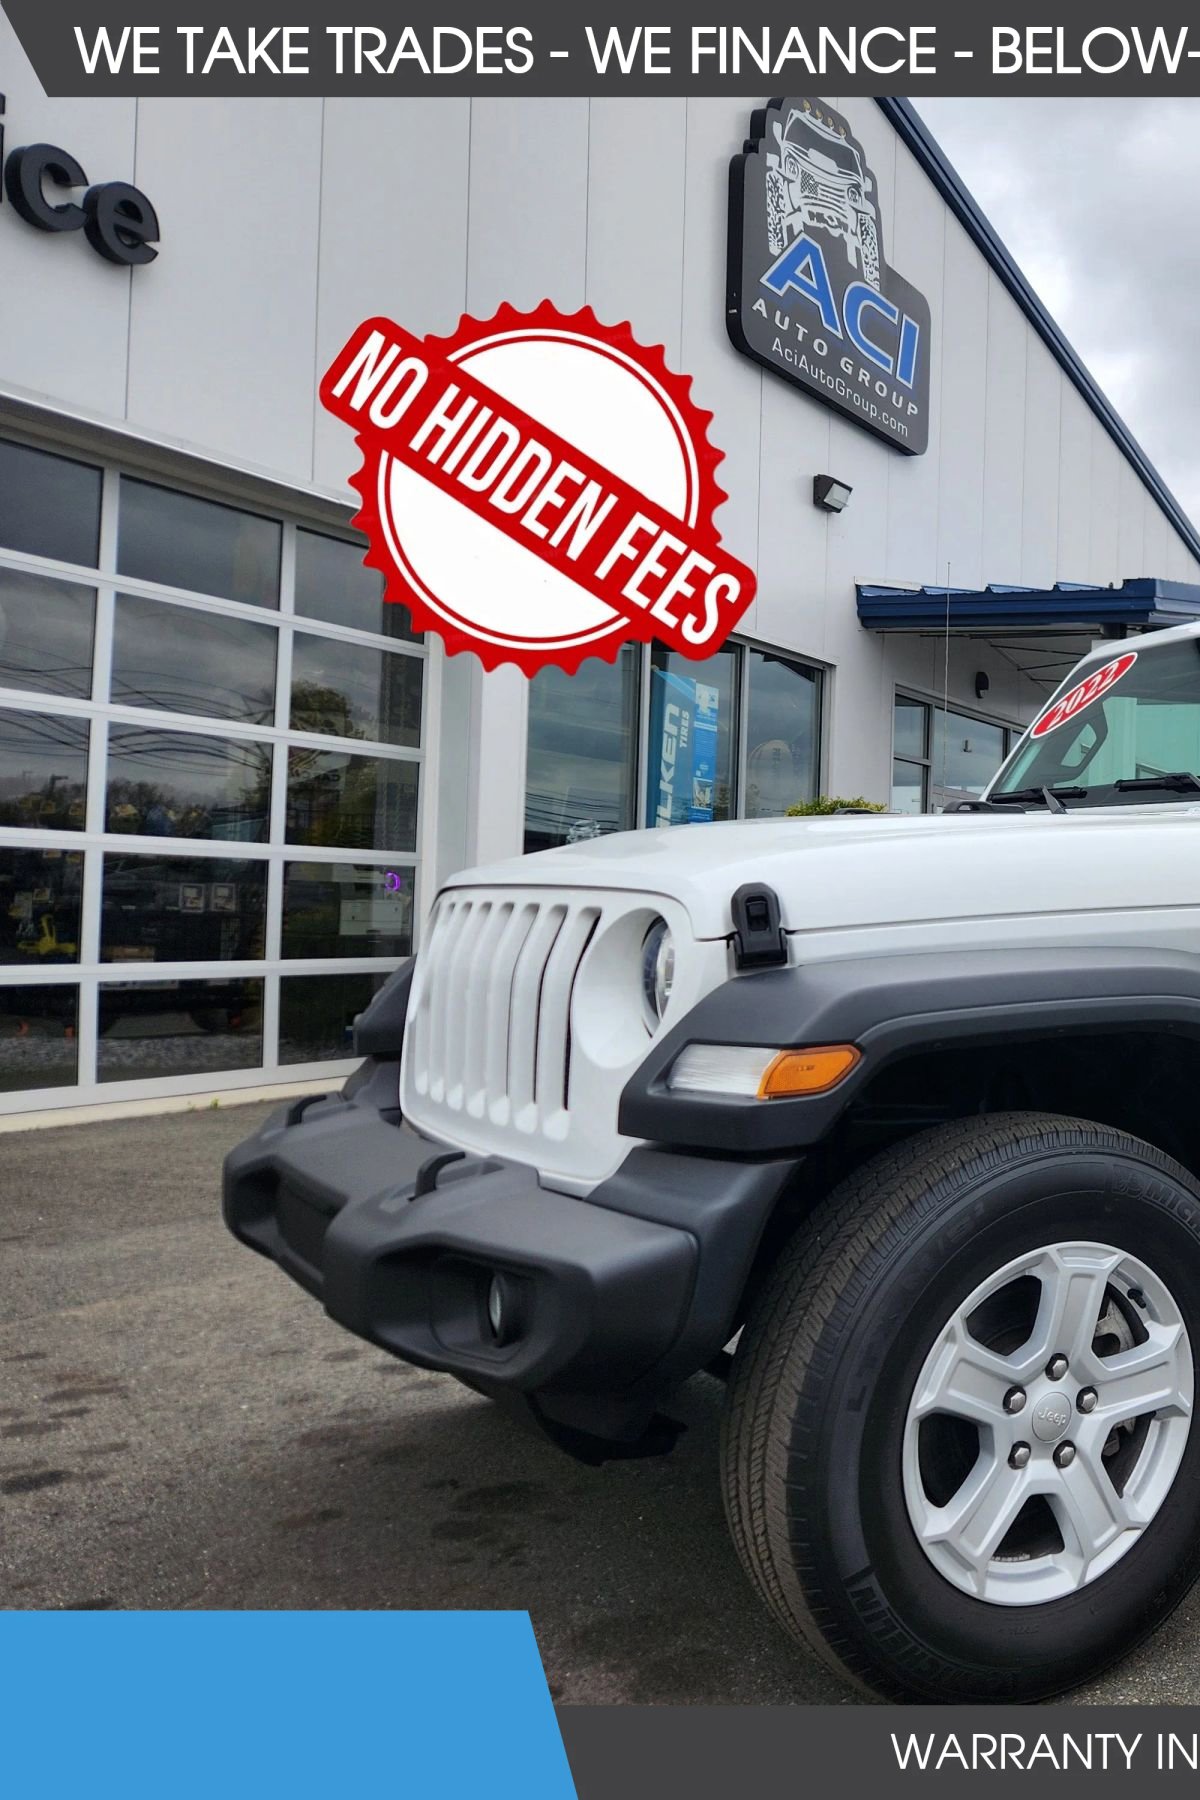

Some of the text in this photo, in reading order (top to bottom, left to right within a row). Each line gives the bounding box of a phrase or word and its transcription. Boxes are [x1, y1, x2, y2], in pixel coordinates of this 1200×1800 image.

[752, 298, 918, 416] AUTO GROUP
[759, 231, 919, 389] ACI
[772, 337, 908, 437] AciAutoGroup.com
[680, 710, 690, 748] TIRES
[1046, 662, 1119, 729] 2022
[656, 703, 680, 828] LKEN
[1038, 1408, 1066, 1426] Jeep
